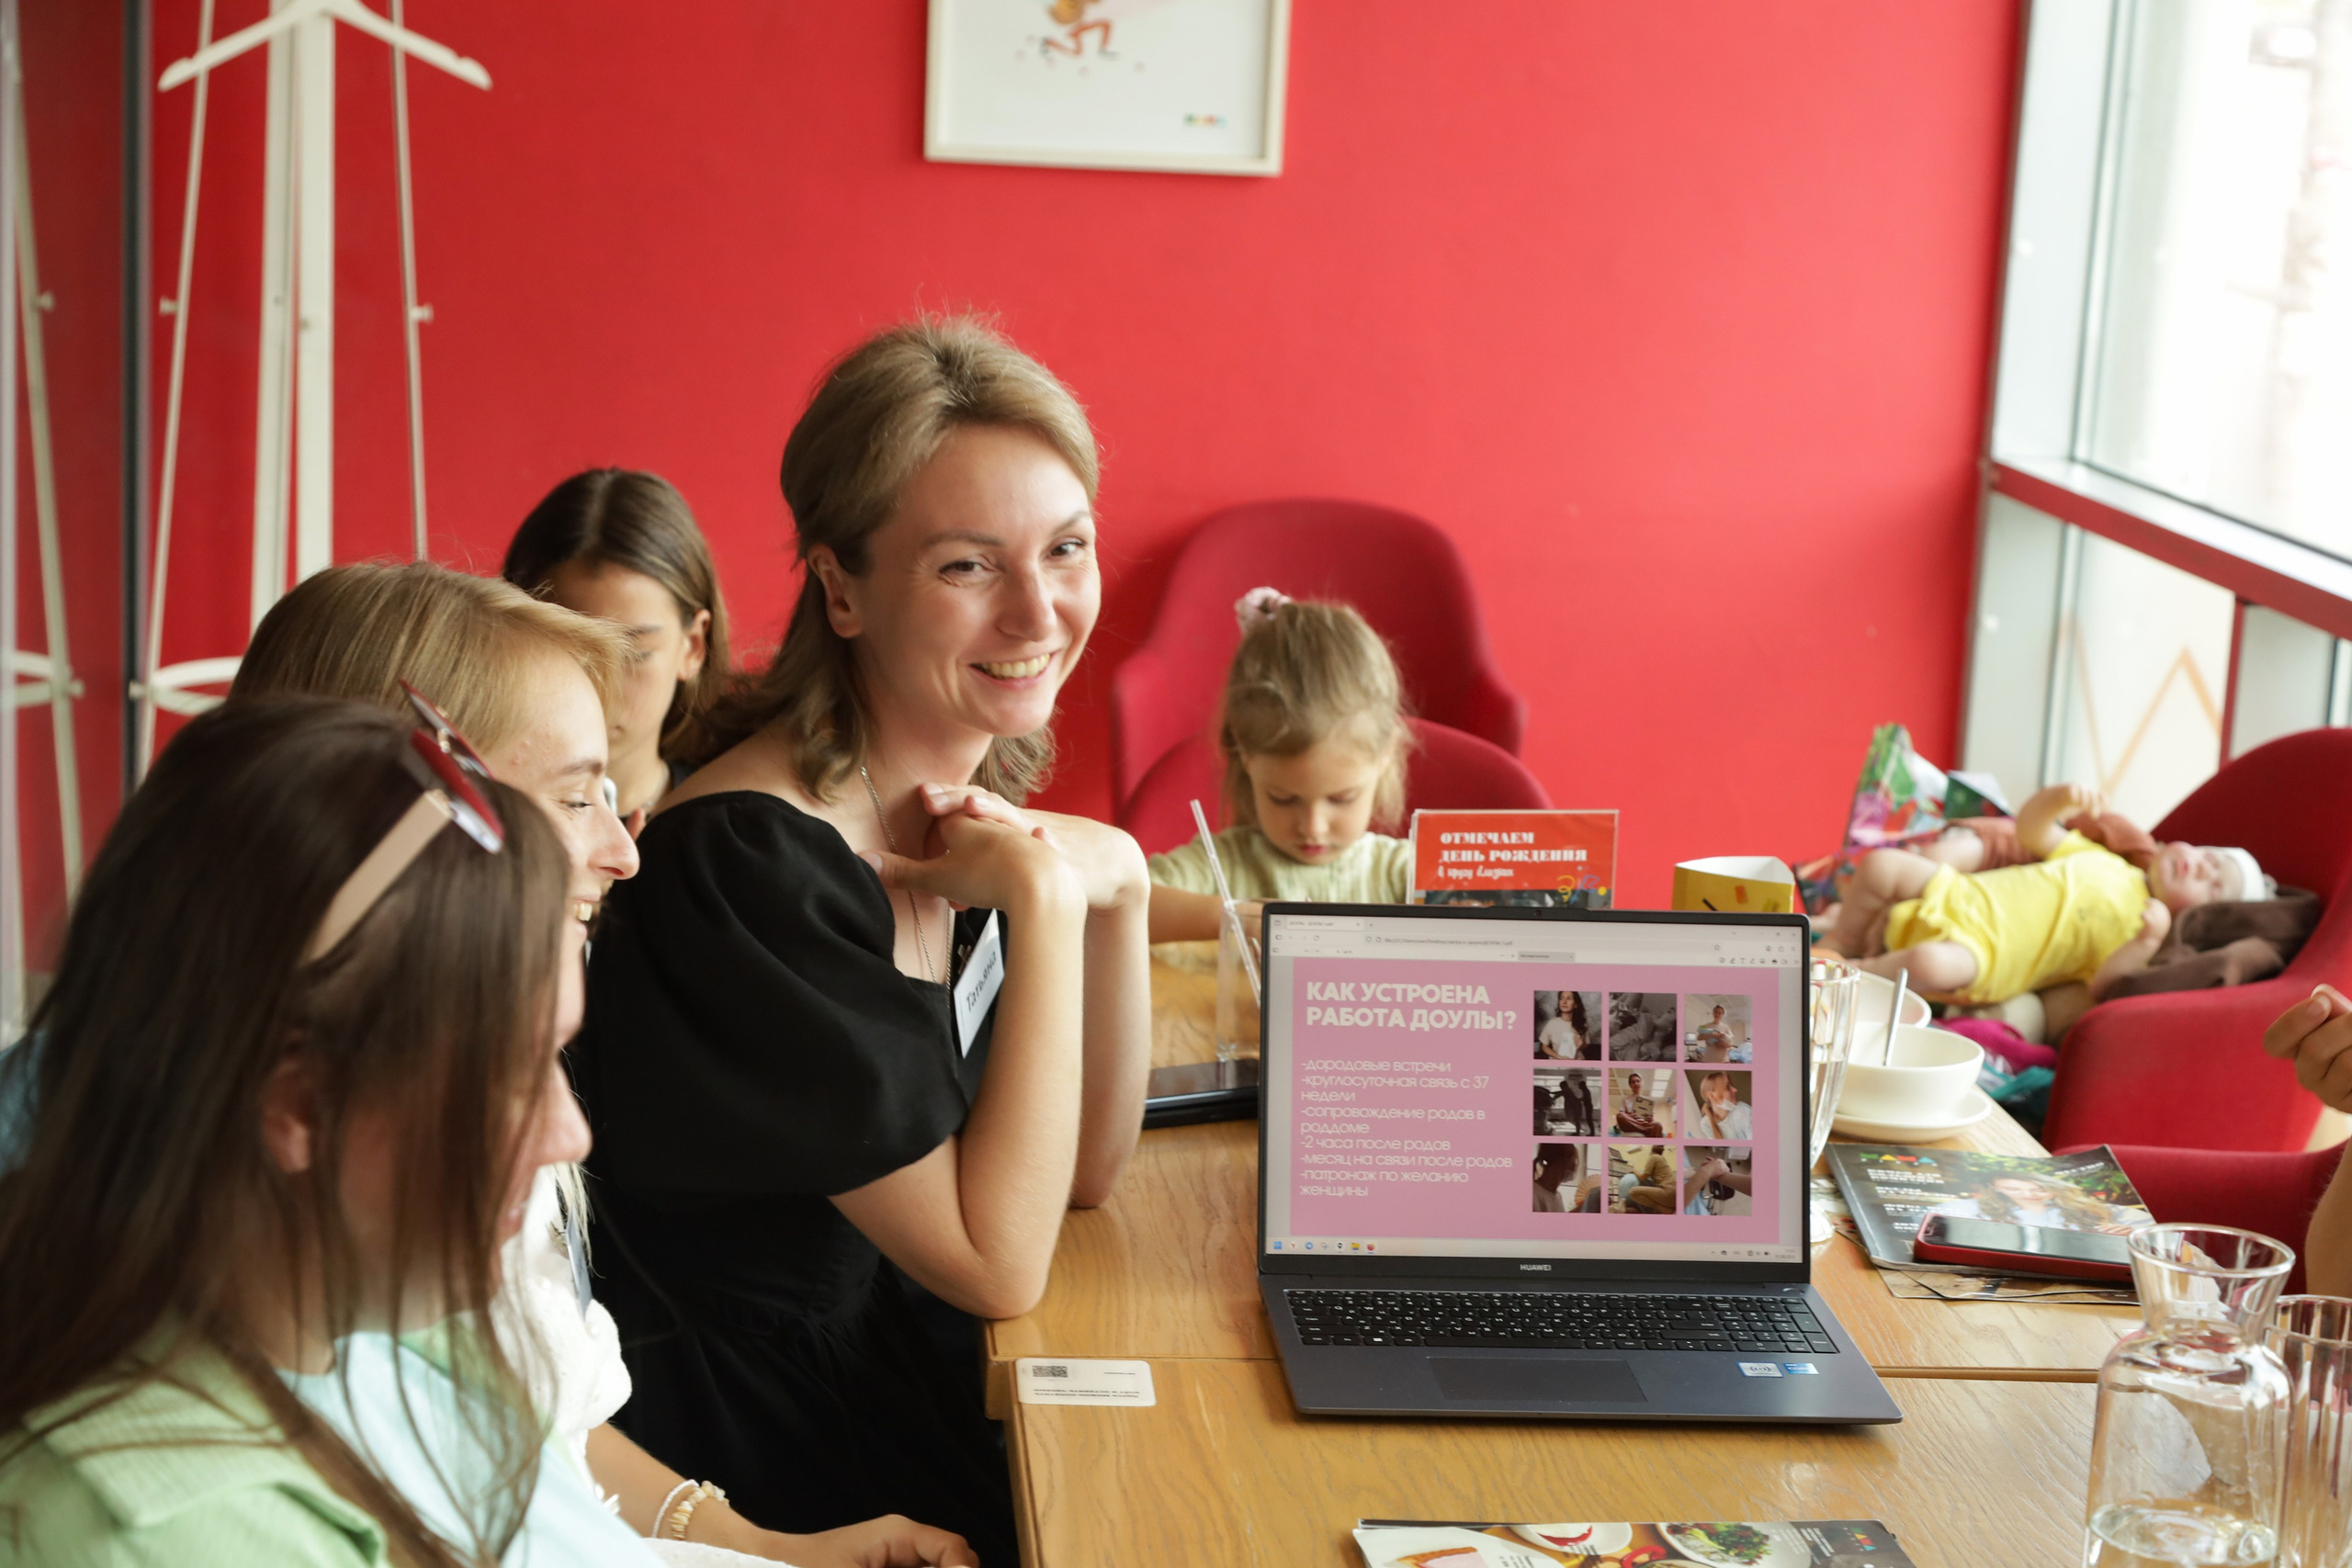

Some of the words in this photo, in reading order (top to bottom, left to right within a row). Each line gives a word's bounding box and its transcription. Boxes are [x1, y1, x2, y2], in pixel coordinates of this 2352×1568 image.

[1440, 831, 1534, 844] ОТМЕЧАЕМ
[1438, 850, 1486, 863] ДЕНЬ
[1488, 849, 1588, 863] РОЖДЕНИЯ
[966, 951, 997, 1012] Татьяна
[1306, 981, 1356, 1001] КАК
[1360, 982, 1491, 1005] УСТРОЕНА
[1306, 1006, 1407, 1028] РАБОТА
[1409, 1009, 1517, 1032] ДОУЛЫ?
[1393, 1061, 1452, 1075] встречи
[1419, 1077, 1458, 1089] связь
[1460, 1077, 1471, 1089] с
[1473, 1076, 1490, 1089] 37
[1300, 1090, 1356, 1102] недели
[1428, 1108, 1475, 1122] родов
[1476, 1110, 1486, 1120] в
[1300, 1122, 1370, 1135] роддоме
[1300, 1135, 1314, 1148] -2
[1316, 1138, 1353, 1149] часа
[1355, 1139, 1402, 1150] после
[1404, 1139, 1452, 1153] родов
[1353, 1155, 1374, 1166] на
[1375, 1155, 1416, 1167] связи
[1418, 1156, 1464, 1168] после
[1465, 1156, 1513, 1169] родов
[1379, 1171, 1398, 1181] по
[1400, 1172, 1470, 1183] желанию
[1300, 1185, 1369, 1198] женщины
